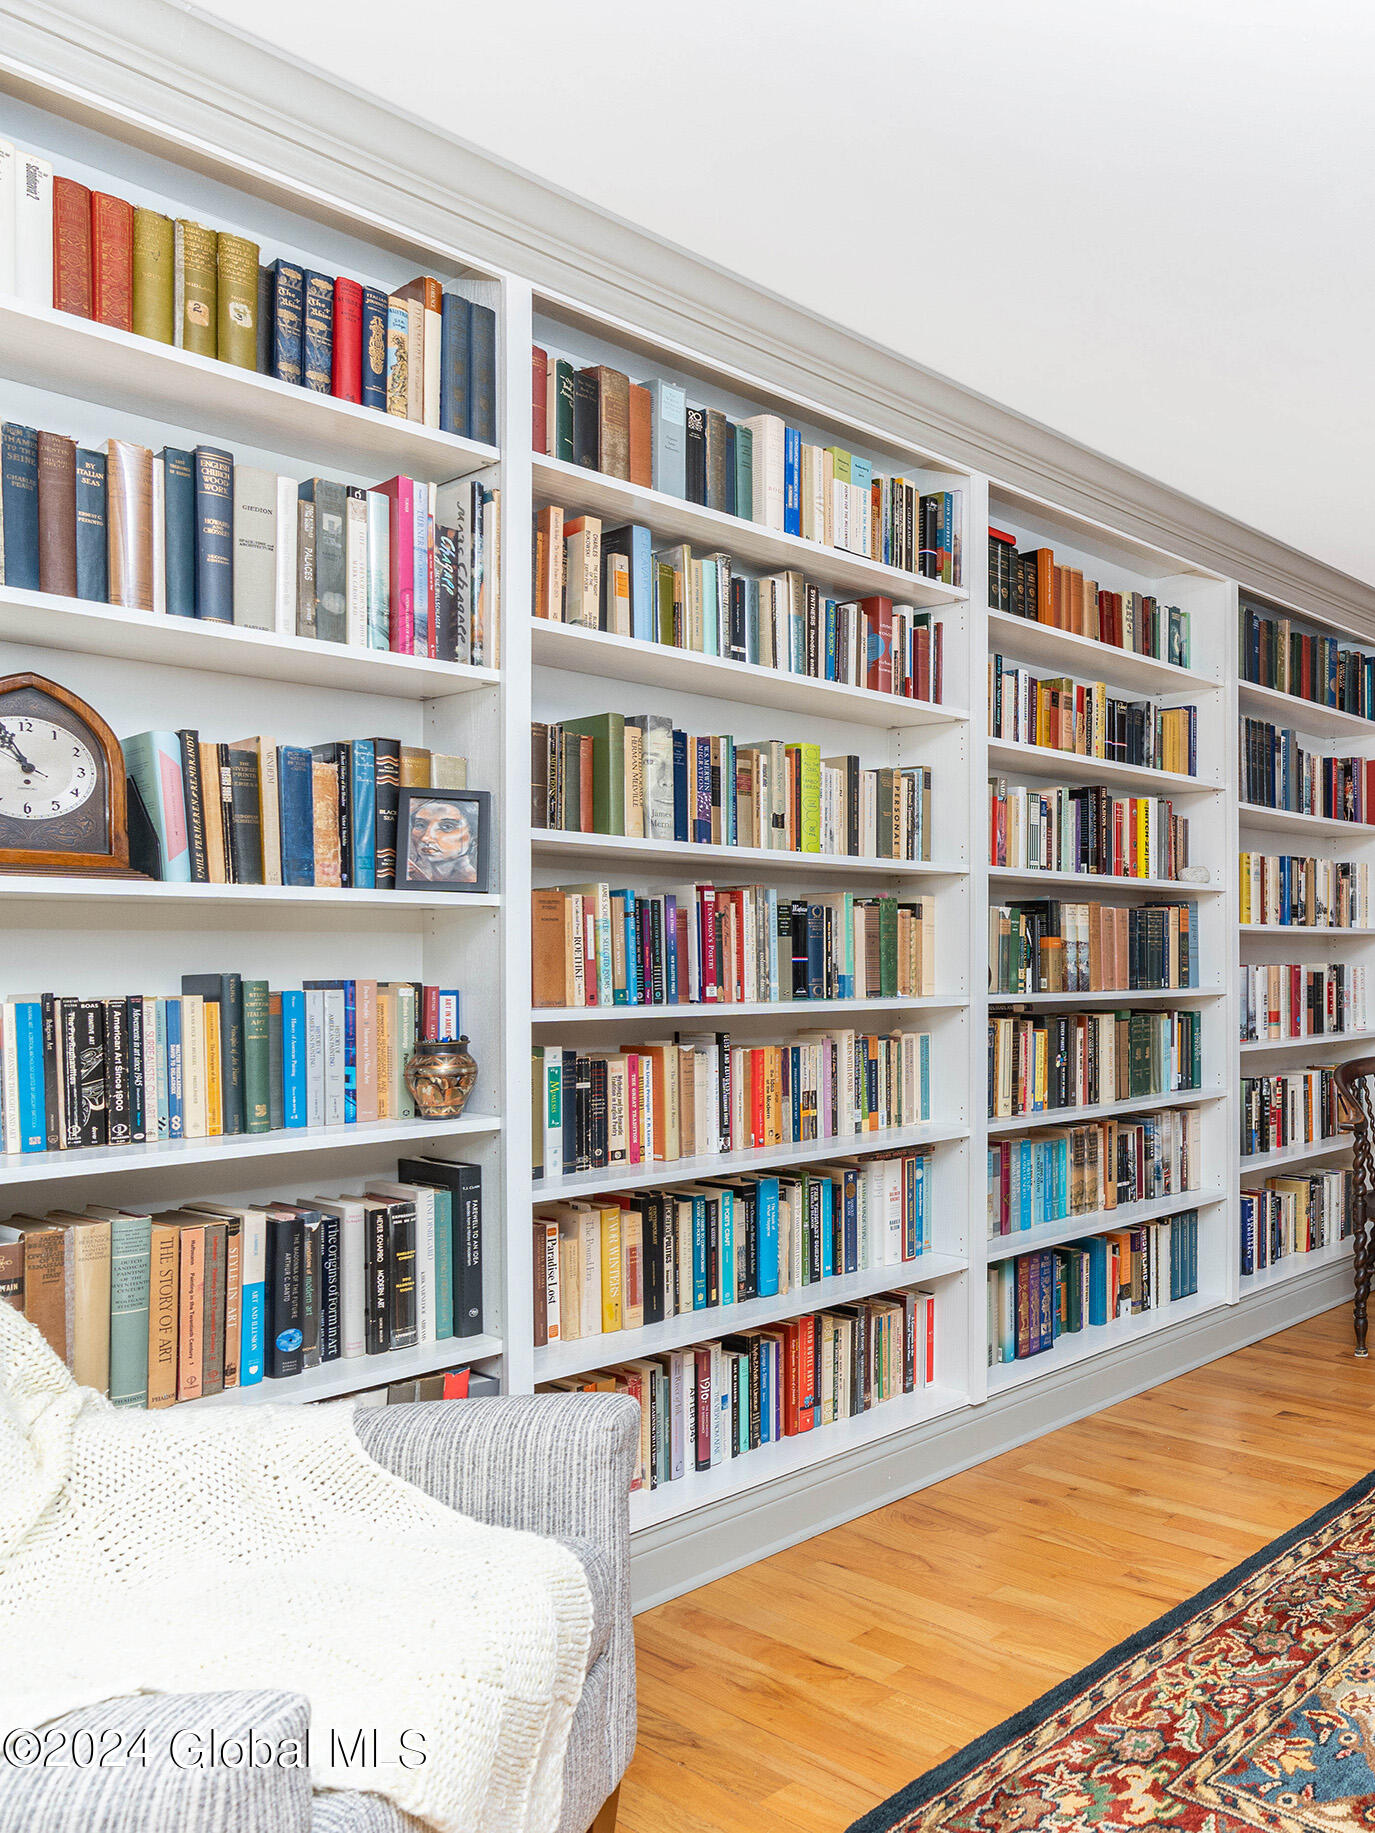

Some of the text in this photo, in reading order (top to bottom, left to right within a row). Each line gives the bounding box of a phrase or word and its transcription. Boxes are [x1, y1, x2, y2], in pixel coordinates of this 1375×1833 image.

[193, 303, 203, 313] 2
[85, 462, 96, 470] BY
[200, 460, 230, 472] ENGLISH
[76, 468, 105, 480] ITALIAN
[201, 467, 230, 480] CHURCH
[81, 478, 101, 487] SEAS
[204, 483, 229, 495] WORK
[242, 504, 274, 516] GIEDION
[416, 509, 426, 546] TURNER
[303, 547, 313, 581] PALACES
[433, 535, 456, 595] Chagall
[19, 721, 33, 733] 12
[52, 730, 57, 740] 1
[73, 747, 81, 757] 2
[186, 734, 198, 794] REMBRANDT
[265, 751, 276, 784] ARNHEIM
[77, 767, 86, 778] 3
[71, 788, 80, 798] 4
[24, 802, 32, 815] 6
[52, 801, 61, 812] 5
[651, 808, 673, 819] James
[574, 936, 583, 981] ROETHKE
[133, 1008, 142, 1040] Movements
[113, 1010, 124, 1112] American Art Since 1900
[134, 1058, 142, 1071] since
[134, 1072, 142, 1086] 1945
[145, 1030, 155, 1119] SURREALISTS ON ART
[550, 1080, 560, 1113] MIMESIS
[472, 1230, 479, 1238] TO
[376, 1235, 384, 1262] SCHAPIRO
[473, 1240, 479, 1249] AN
[585, 1220, 595, 1282] The Pound Era
[607, 1215, 621, 1298] YVOR WINTERS
[42, 1272, 61, 1280] ITALY
[547, 1238, 558, 1305] Paradise Lost
[227, 1247, 238, 1328] STYLE IN ART
[305, 1276, 313, 1303] modern
[325, 1223, 340, 1355] The Origins of Form in Art
[158, 1236, 174, 1364] THE STORY OF ART
[305, 1306, 314, 1316] art
[700, 1377, 710, 1403] 1910:
